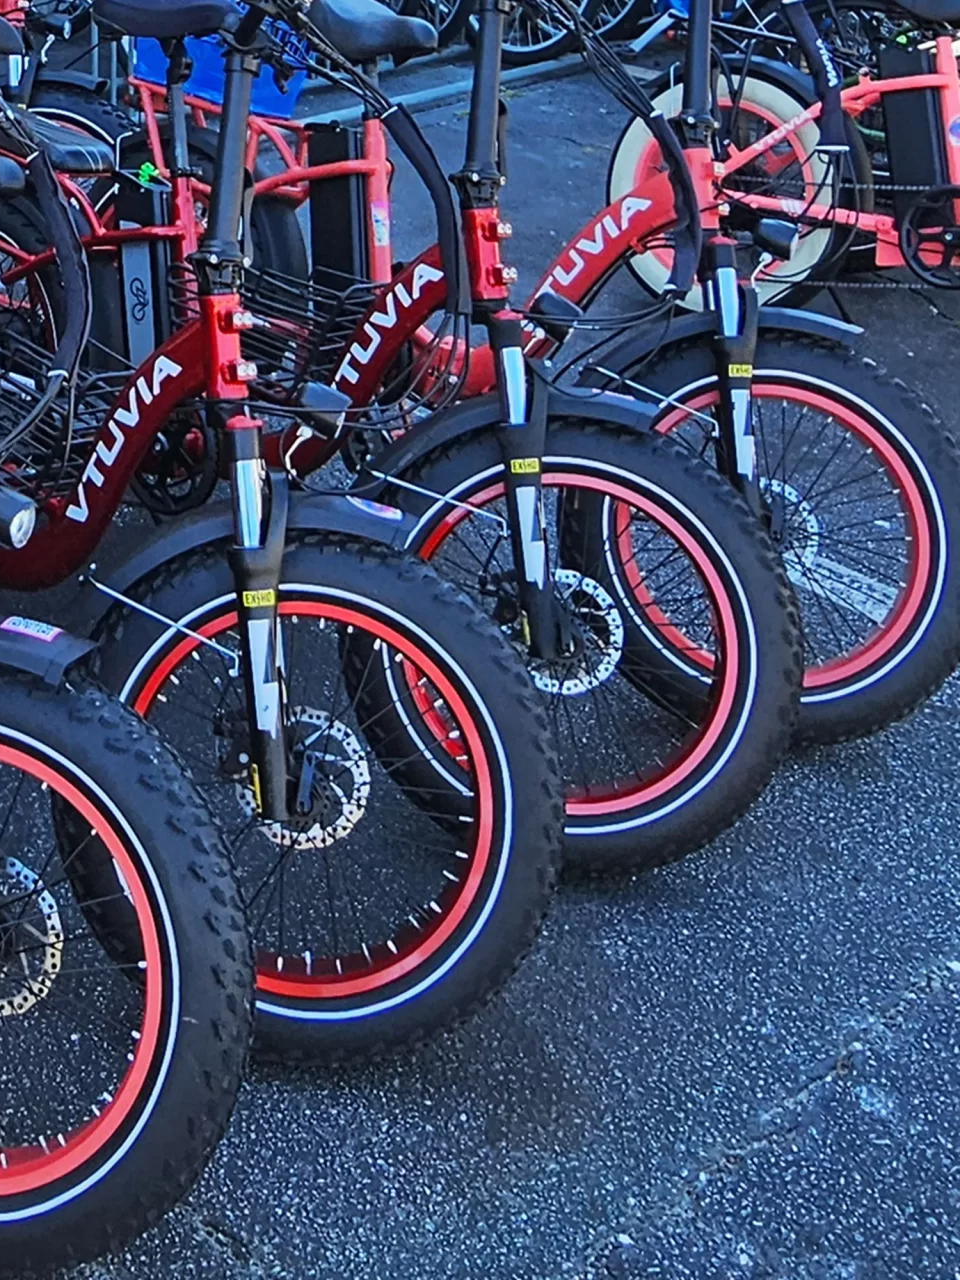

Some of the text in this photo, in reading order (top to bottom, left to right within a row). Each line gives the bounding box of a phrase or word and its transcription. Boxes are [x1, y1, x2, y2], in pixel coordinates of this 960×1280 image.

[530, 196, 652, 305] TUVIA
[330, 263, 444, 390] TUVIA
[65, 354, 183, 524] VTUVIA
